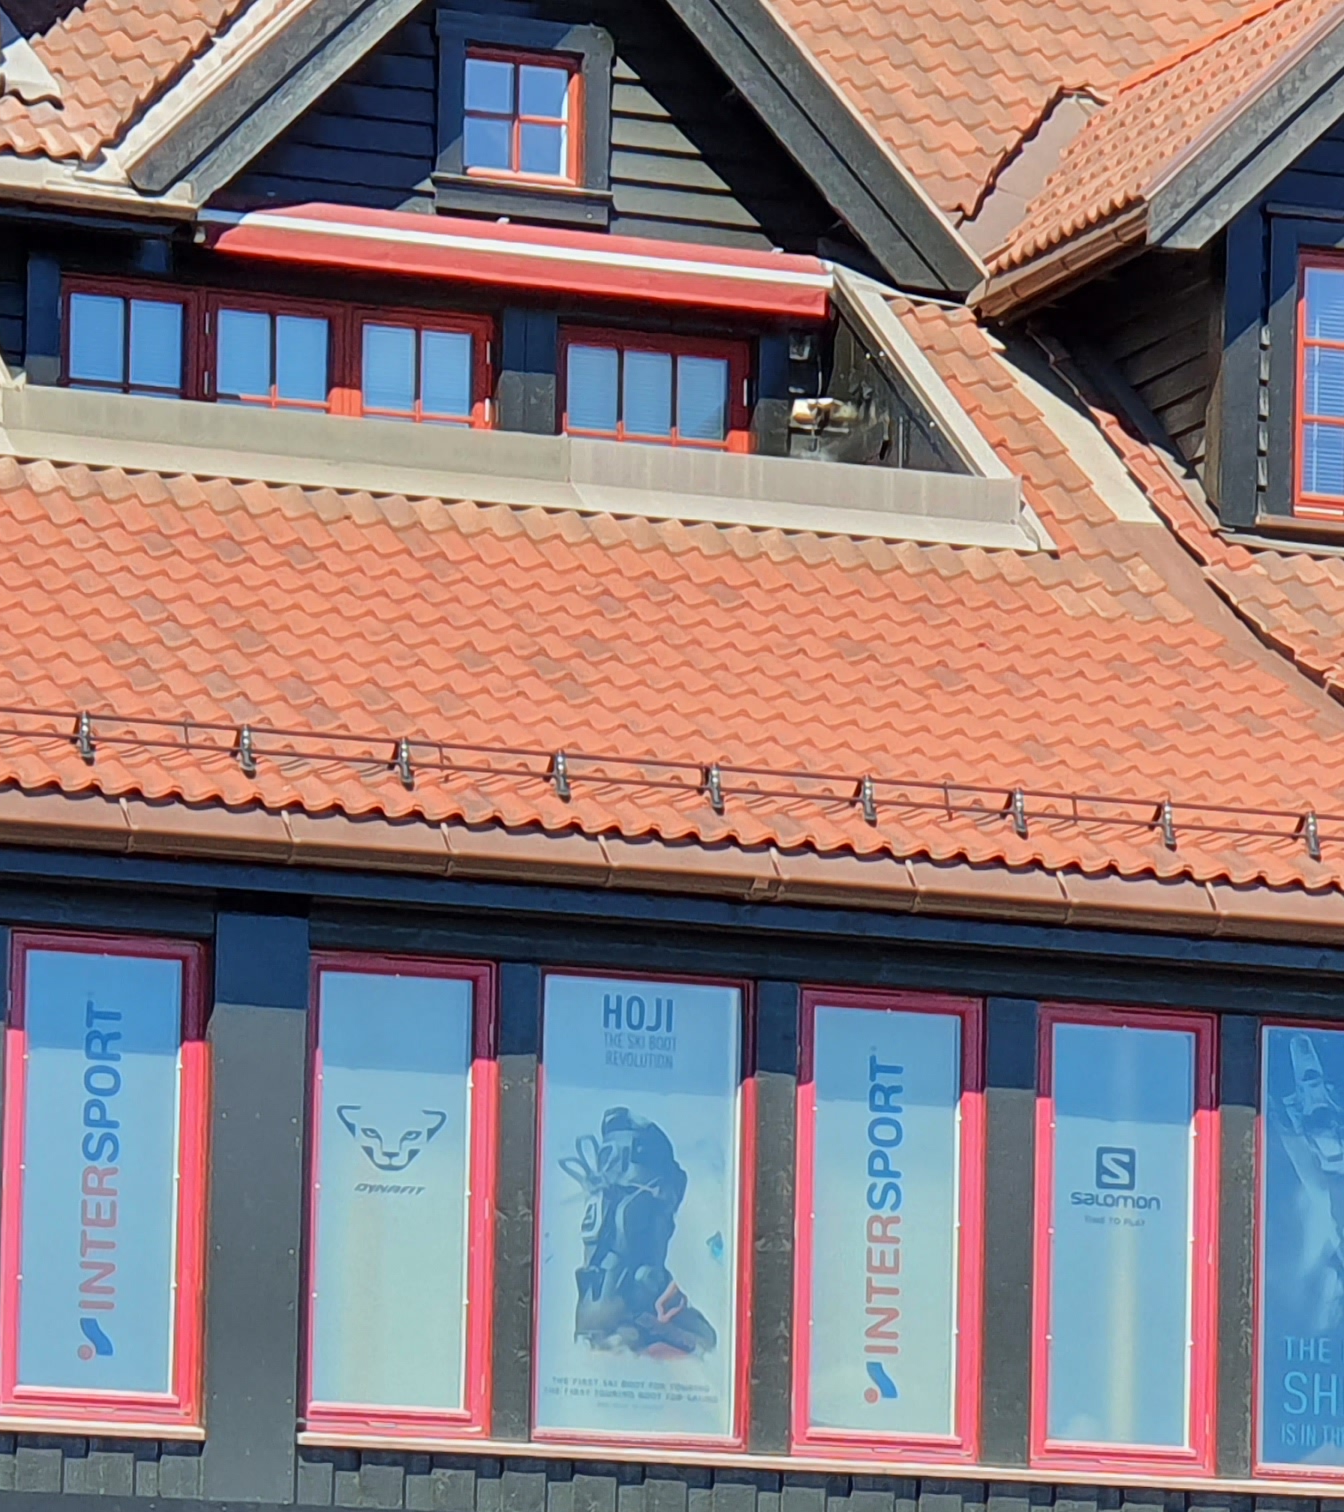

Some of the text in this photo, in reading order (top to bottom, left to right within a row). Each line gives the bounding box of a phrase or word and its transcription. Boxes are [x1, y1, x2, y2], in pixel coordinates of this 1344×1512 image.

[603, 993, 674, 1033] HOJI
[604, 1032, 676, 1052] THE SKI BOOT
[605, 1050, 674, 1070] REVOLUTION
[78, 1000, 123, 1310] INTERSPORT
[354, 1183, 426, 1195] DYNAFIT
[864, 1055, 904, 1354] INTERSPORT
[1284, 1336, 1332, 1364] THE
[1281, 1423, 1296, 1446] IS
[1300, 1424, 1316, 1447] IN
